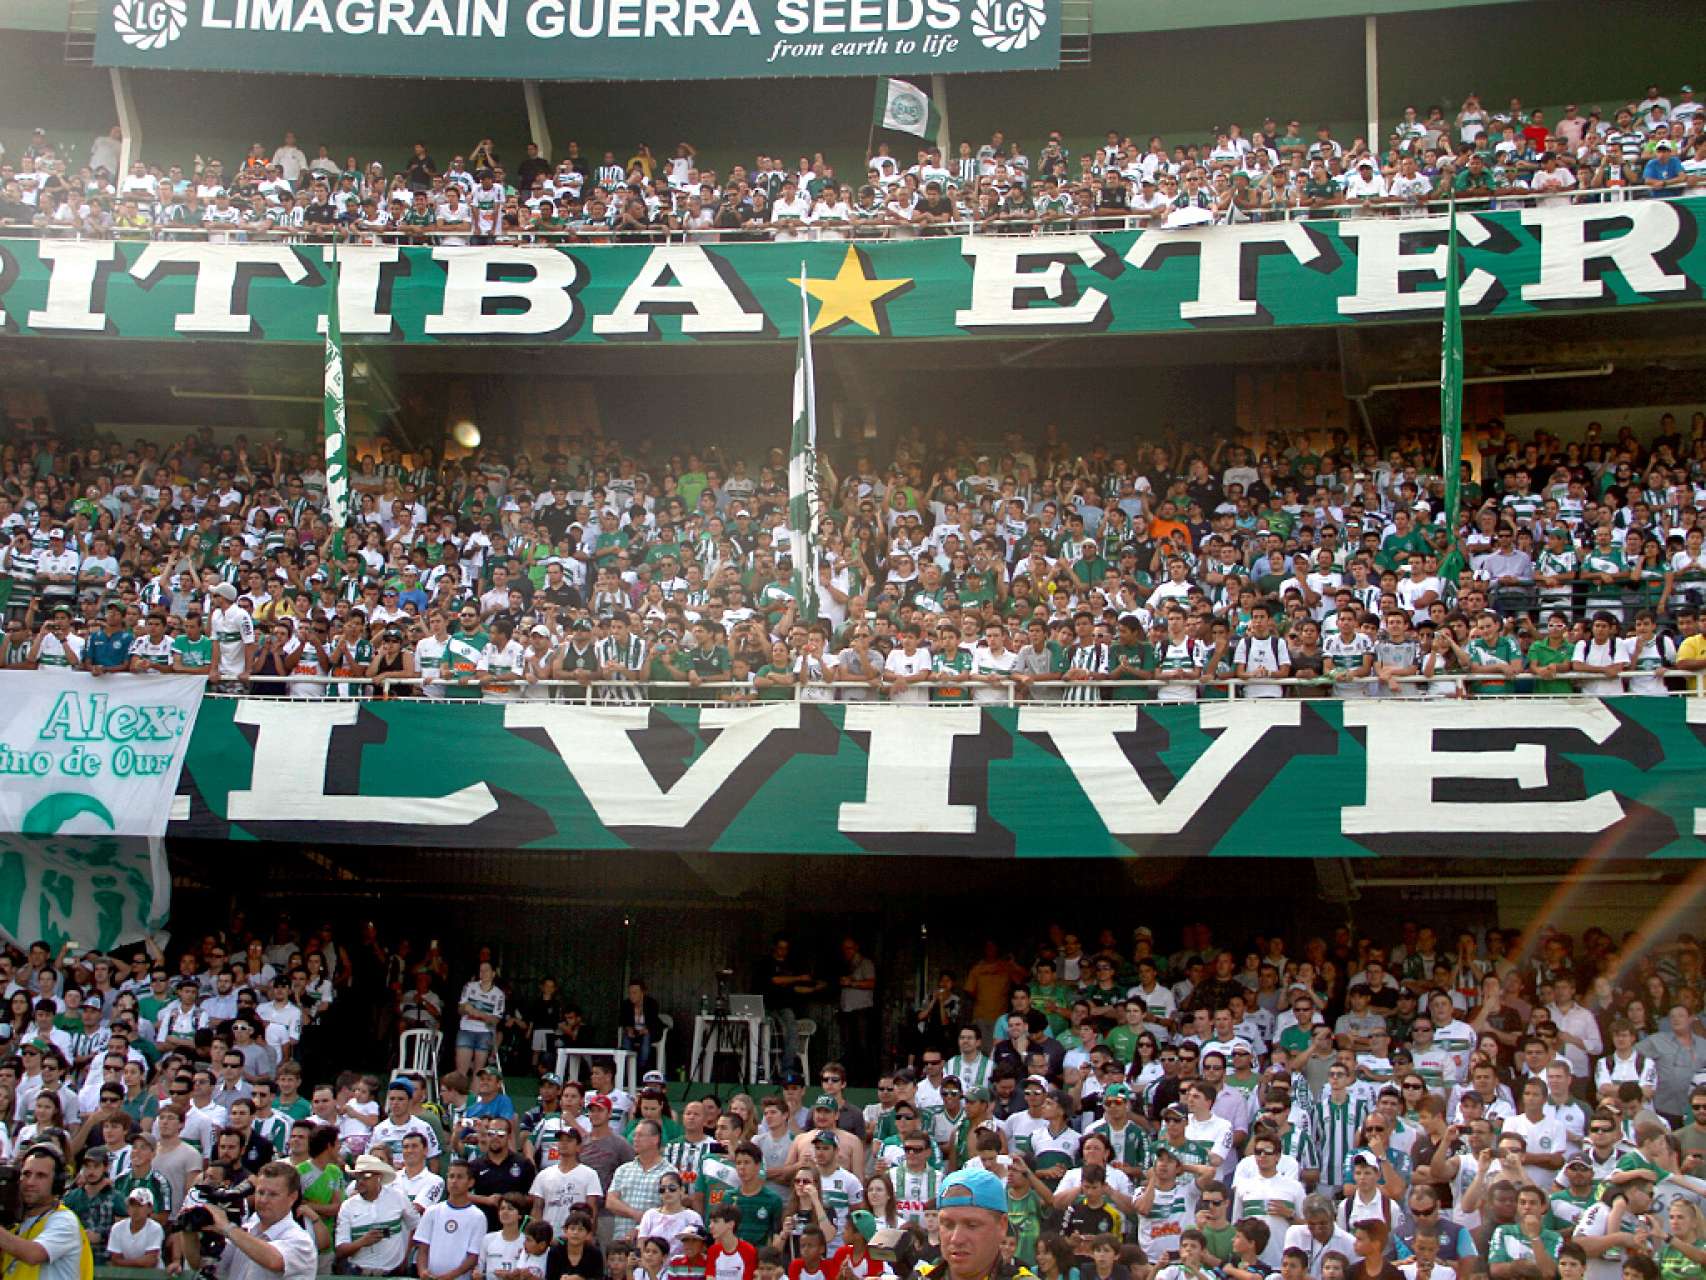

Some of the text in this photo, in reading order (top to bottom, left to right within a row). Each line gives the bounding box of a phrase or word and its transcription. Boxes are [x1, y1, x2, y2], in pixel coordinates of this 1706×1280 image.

[135, 1, 168, 31] LG
[201, 0, 960, 38] LIMAGRAIN GUERRA SEEDS
[994, 2, 1025, 32] LG
[767, 34, 959, 63] from earth to life
[0, 240, 765, 334] ITIBA
[60, 744, 101, 778] de
